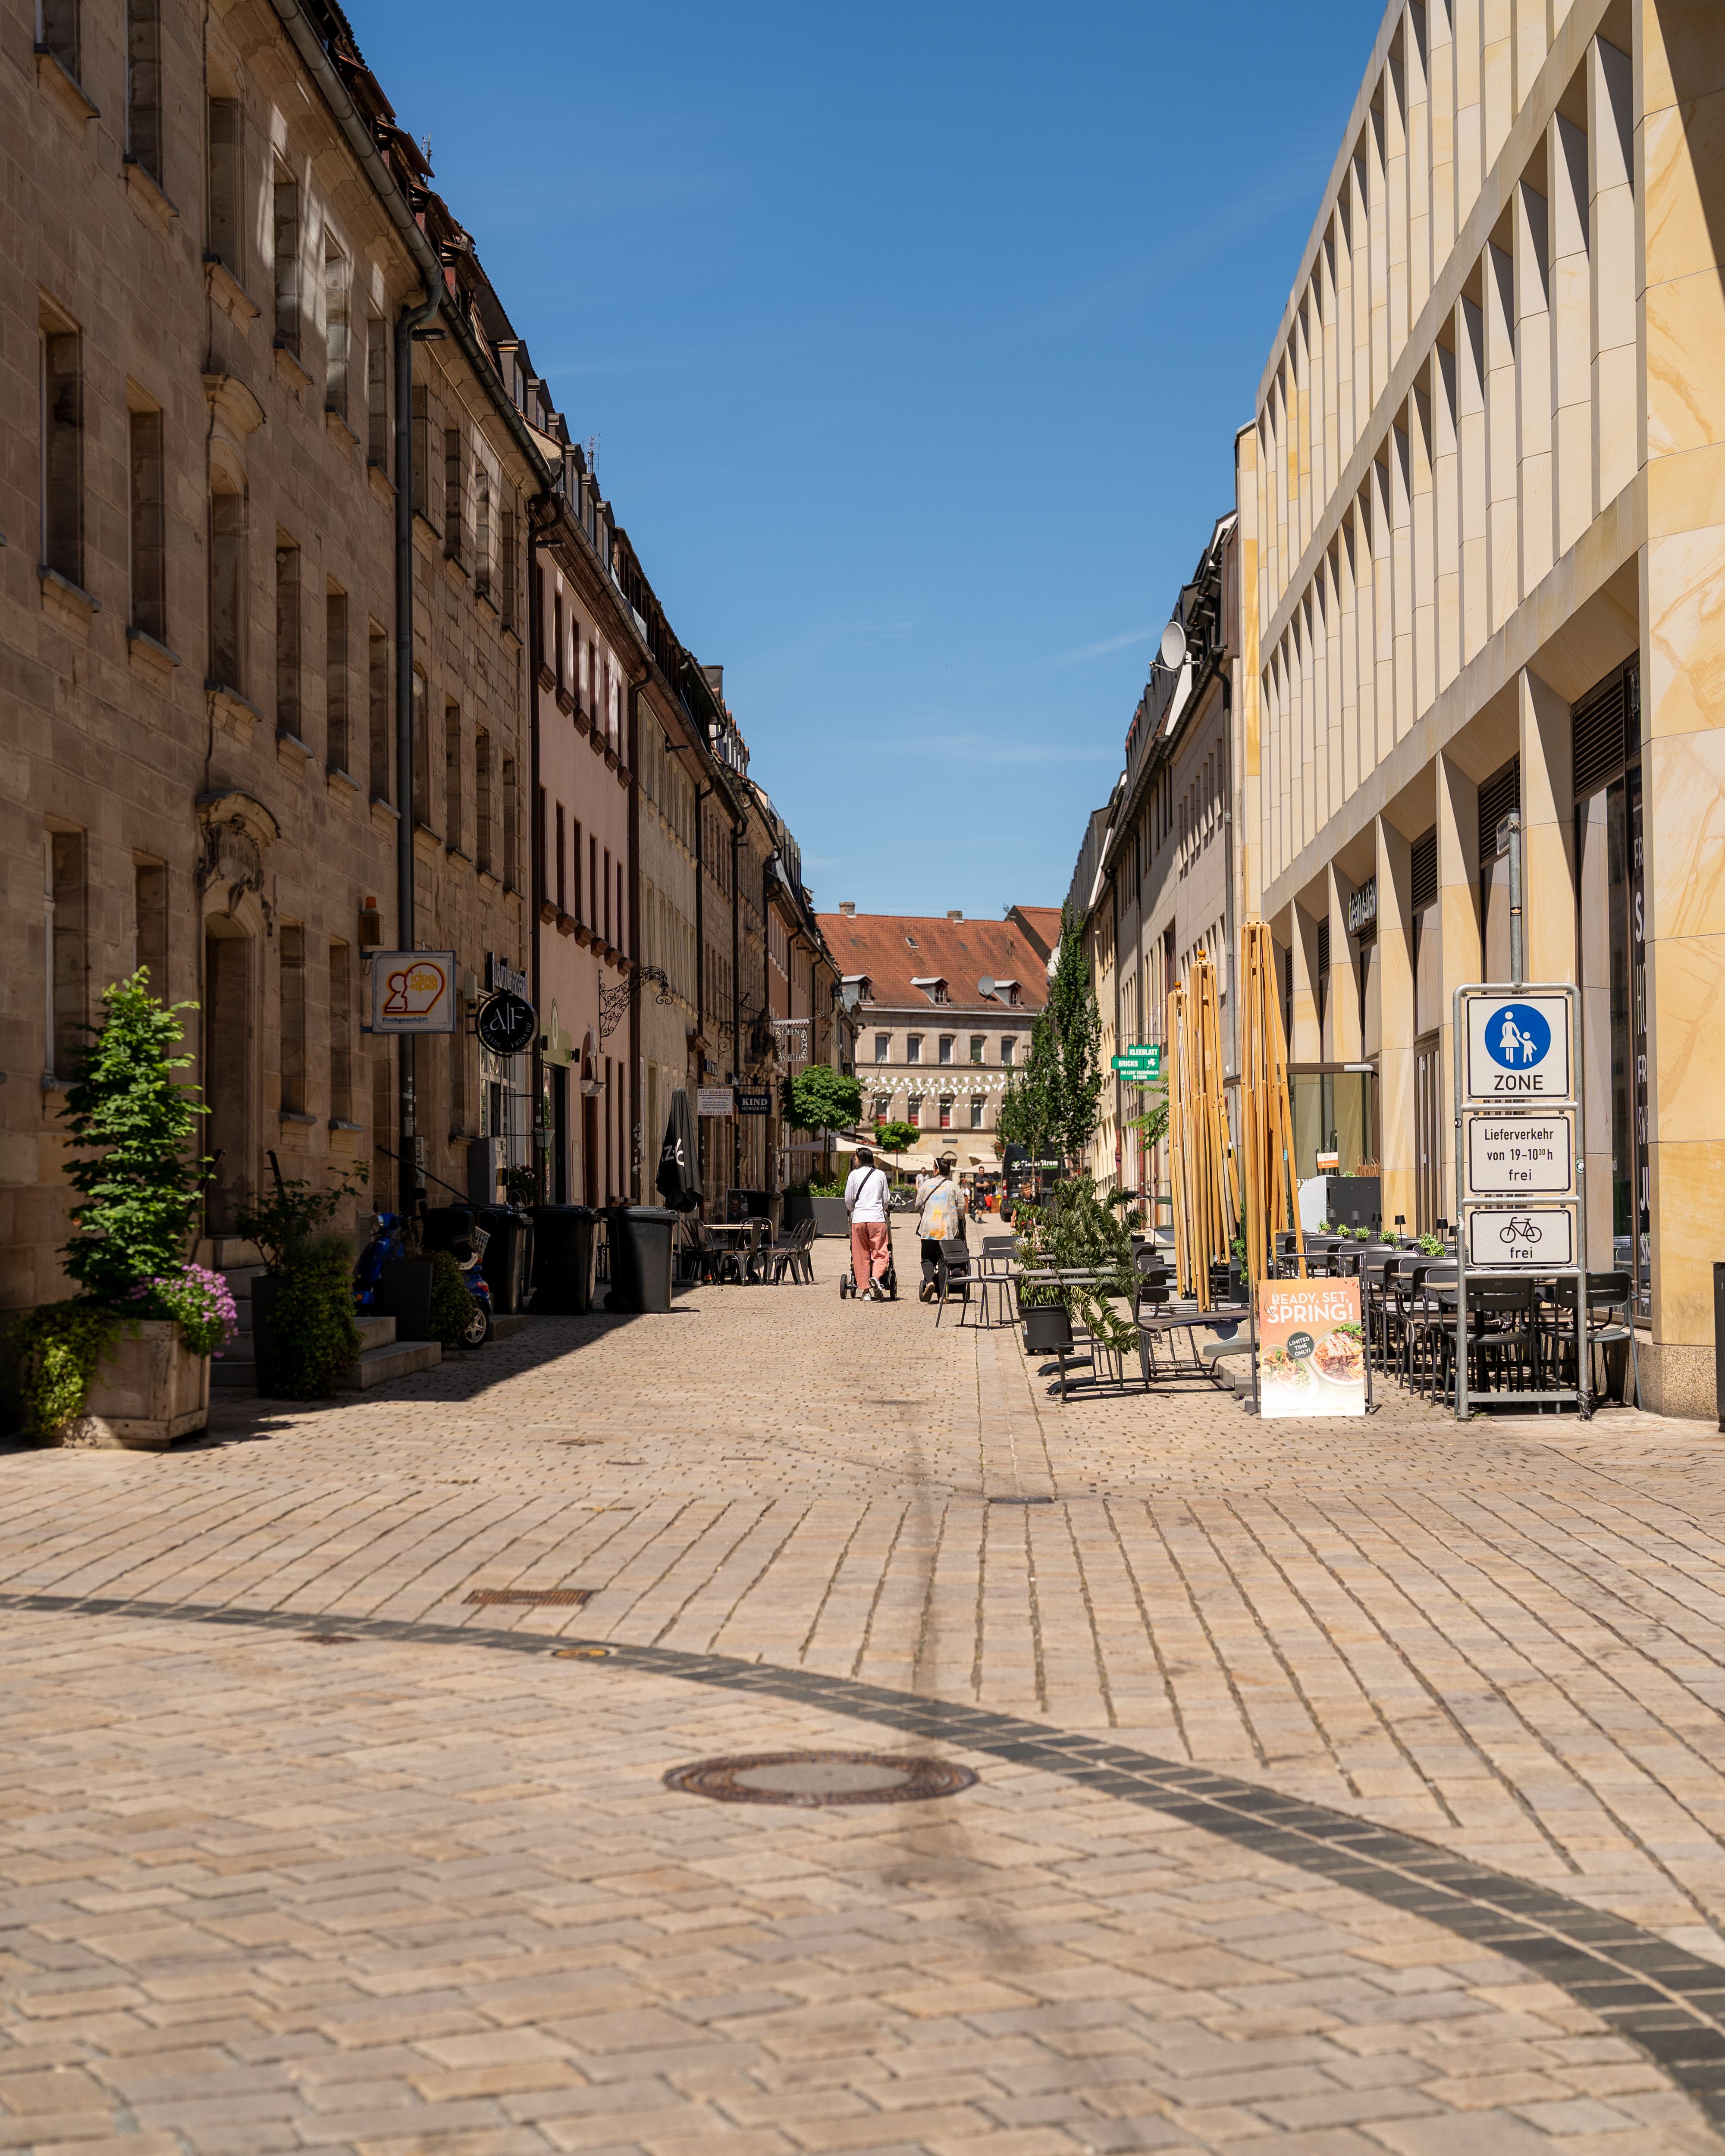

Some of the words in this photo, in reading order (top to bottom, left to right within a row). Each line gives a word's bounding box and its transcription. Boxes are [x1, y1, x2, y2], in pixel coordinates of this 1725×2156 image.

[1634, 836, 1643, 869] FR
[411, 969, 435, 983] idee
[483, 1025, 500, 1047] AFANDI
[511, 1022, 532, 1048] FRISEUR
[1638, 1054, 1647, 1083] FR
[1494, 1075, 1543, 1091] ZONE
[1485, 1128, 1554, 1141] Lieferverkehr
[1487, 1152, 1505, 1161] von
[1509, 1169, 1532, 1181] frei
[1510, 1247, 1533, 1259] frei
[1271, 1292, 1319, 1305] READY,
[1322, 1291, 1349, 1304] SET,
[1267, 1303, 1354, 1324] SPRING!
[1288, 1336, 1310, 1346] LIMITED
[1294, 1342, 1308, 1351] TIME
[1294, 1348, 1311, 1357] ONLY!
